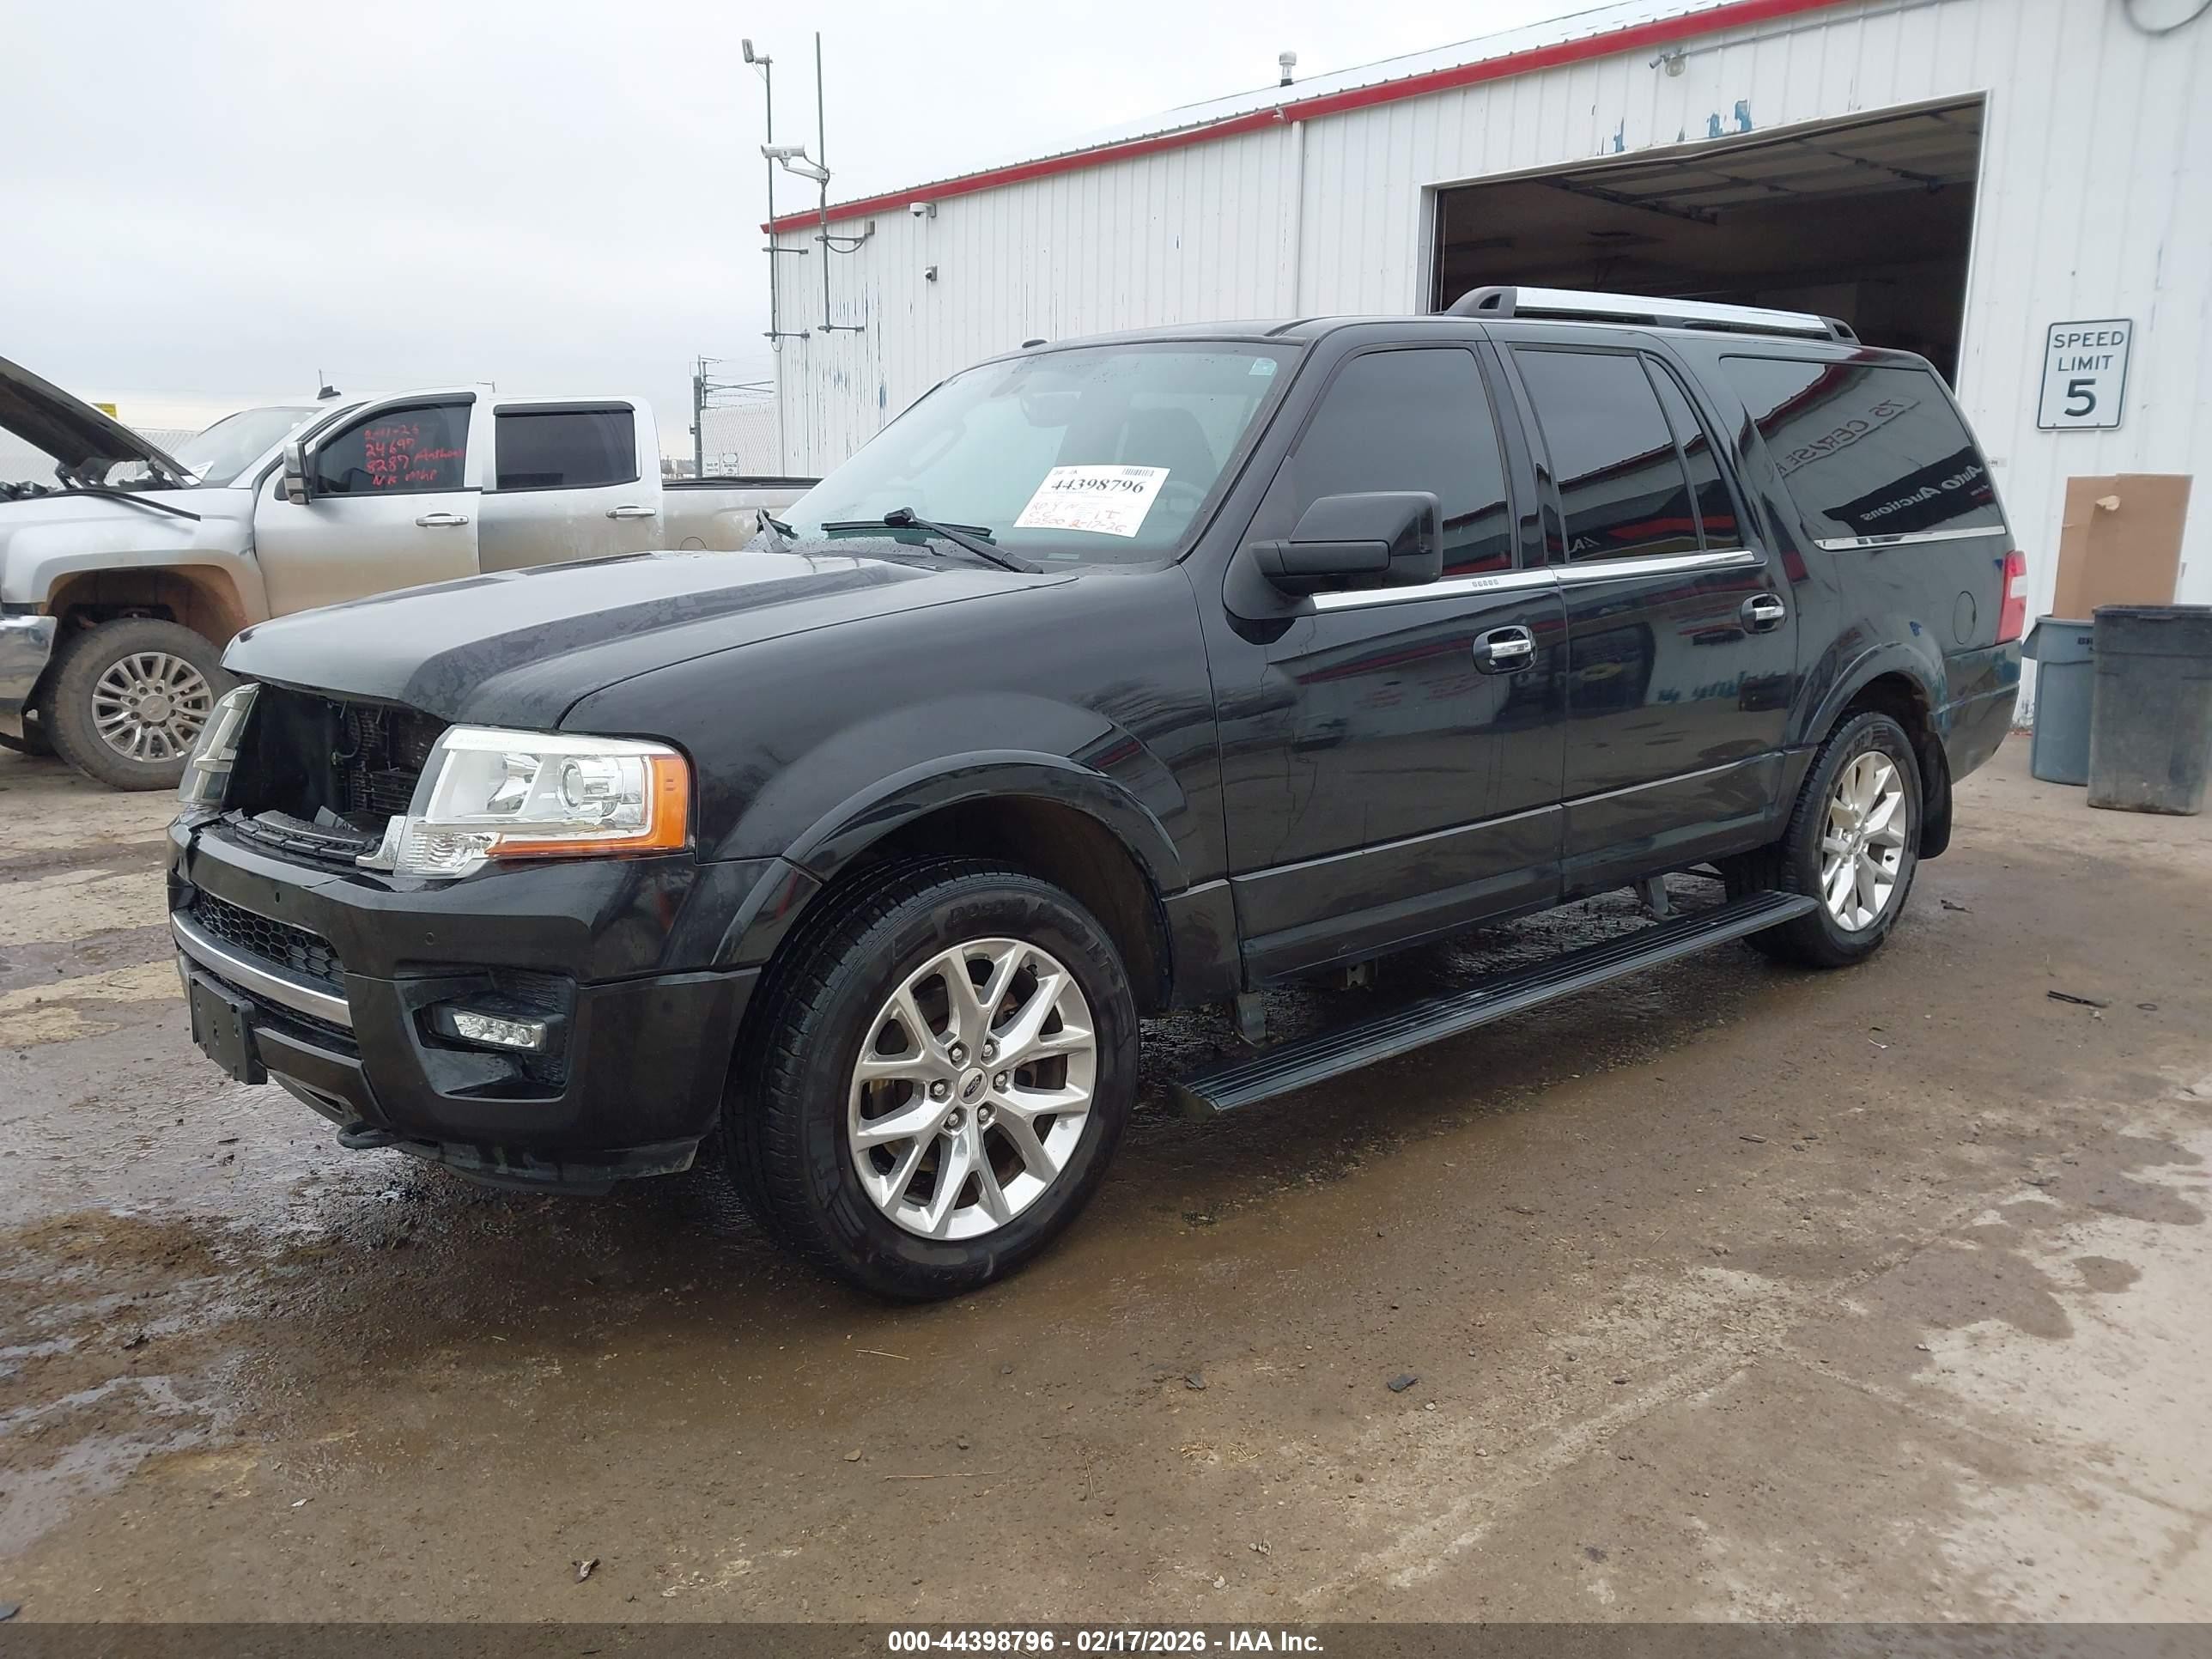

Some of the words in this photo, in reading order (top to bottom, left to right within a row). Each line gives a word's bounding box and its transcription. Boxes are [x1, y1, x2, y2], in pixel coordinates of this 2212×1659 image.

[2053, 331, 2125, 349] SPEED
[2057, 354, 2114, 372] LIMIT
[2063, 378, 2097, 417] 5
[366, 454, 410, 473] 8287
[1050, 477, 1148, 495] 44398796
